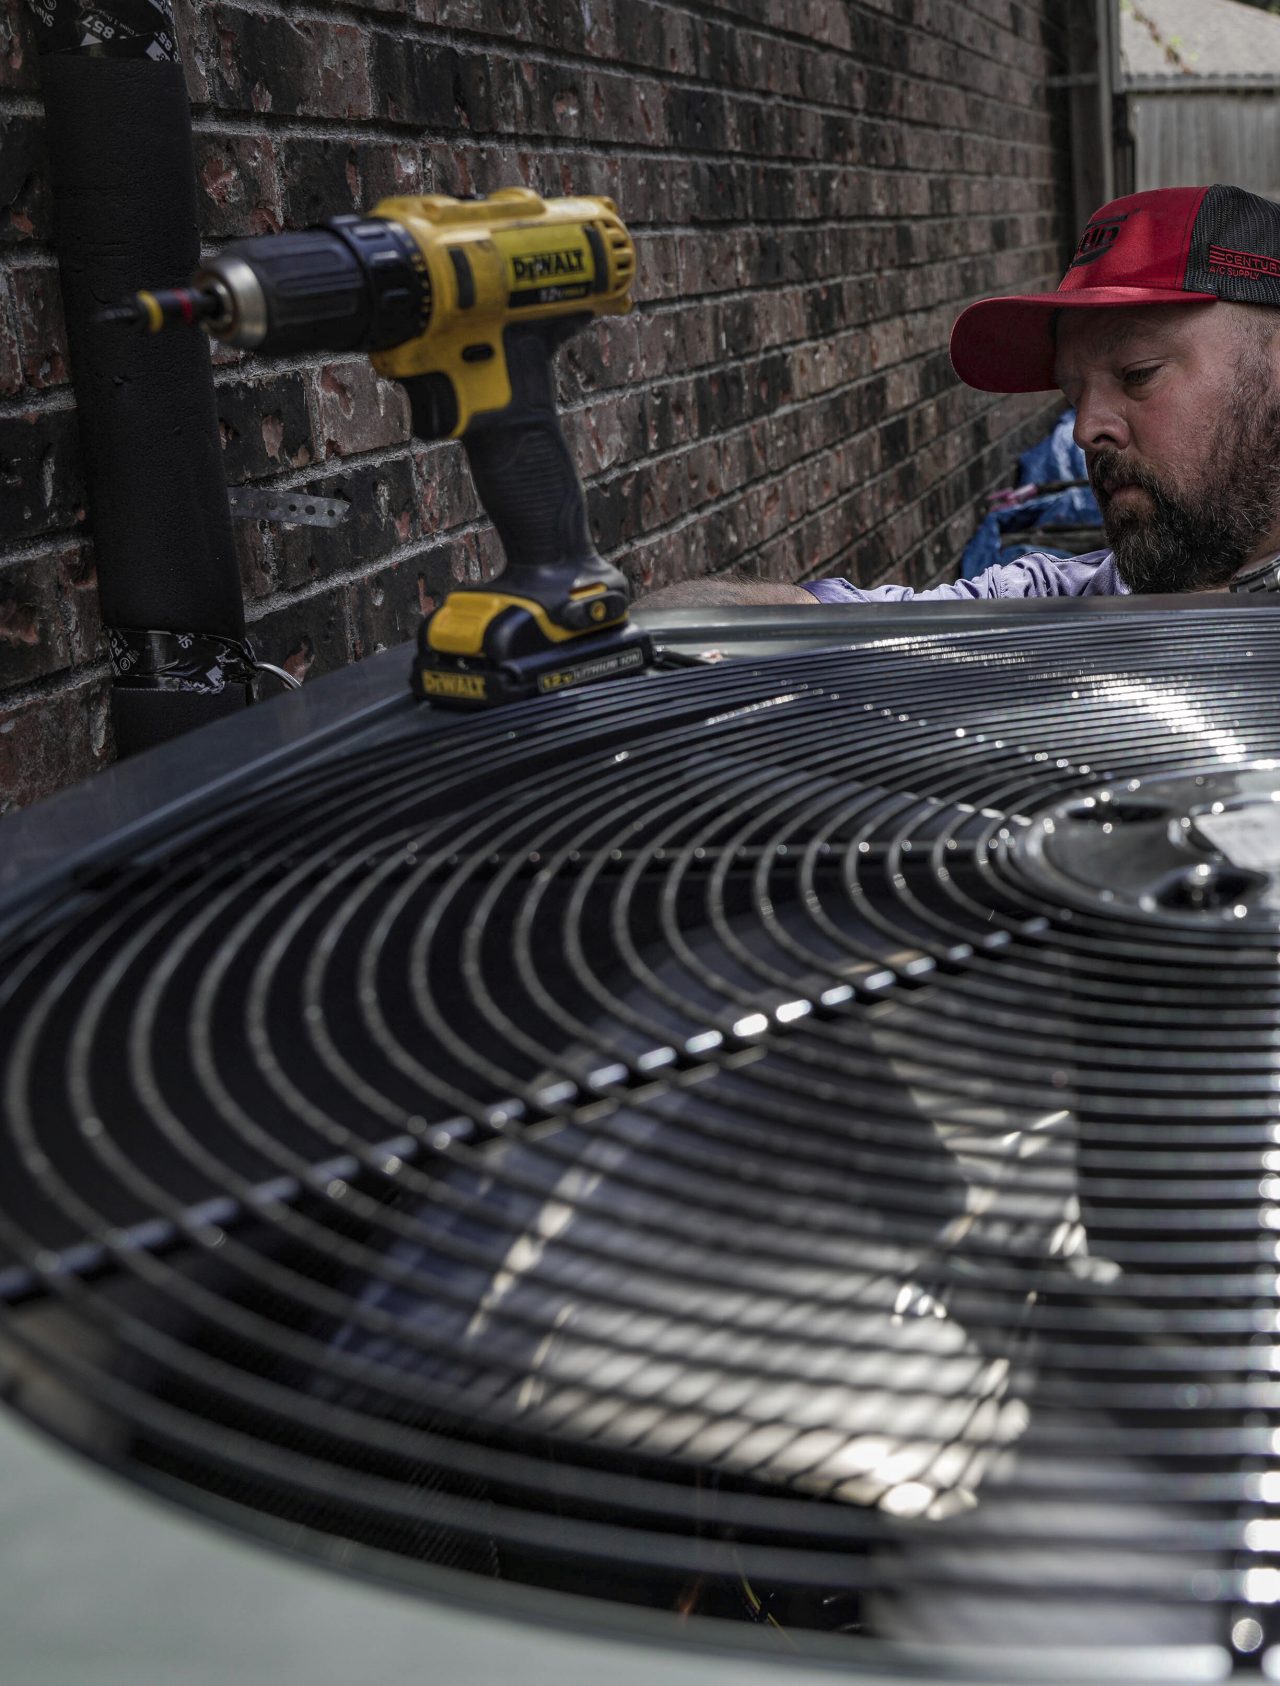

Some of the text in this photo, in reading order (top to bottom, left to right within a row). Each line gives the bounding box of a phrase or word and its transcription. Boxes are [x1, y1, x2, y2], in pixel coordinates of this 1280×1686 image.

[82, 15, 115, 39] 857
[1209, 265, 1260, 280] A/C SUPPLY
[575, 659, 618, 679] LITHIUM
[621, 653, 640, 666] ION
